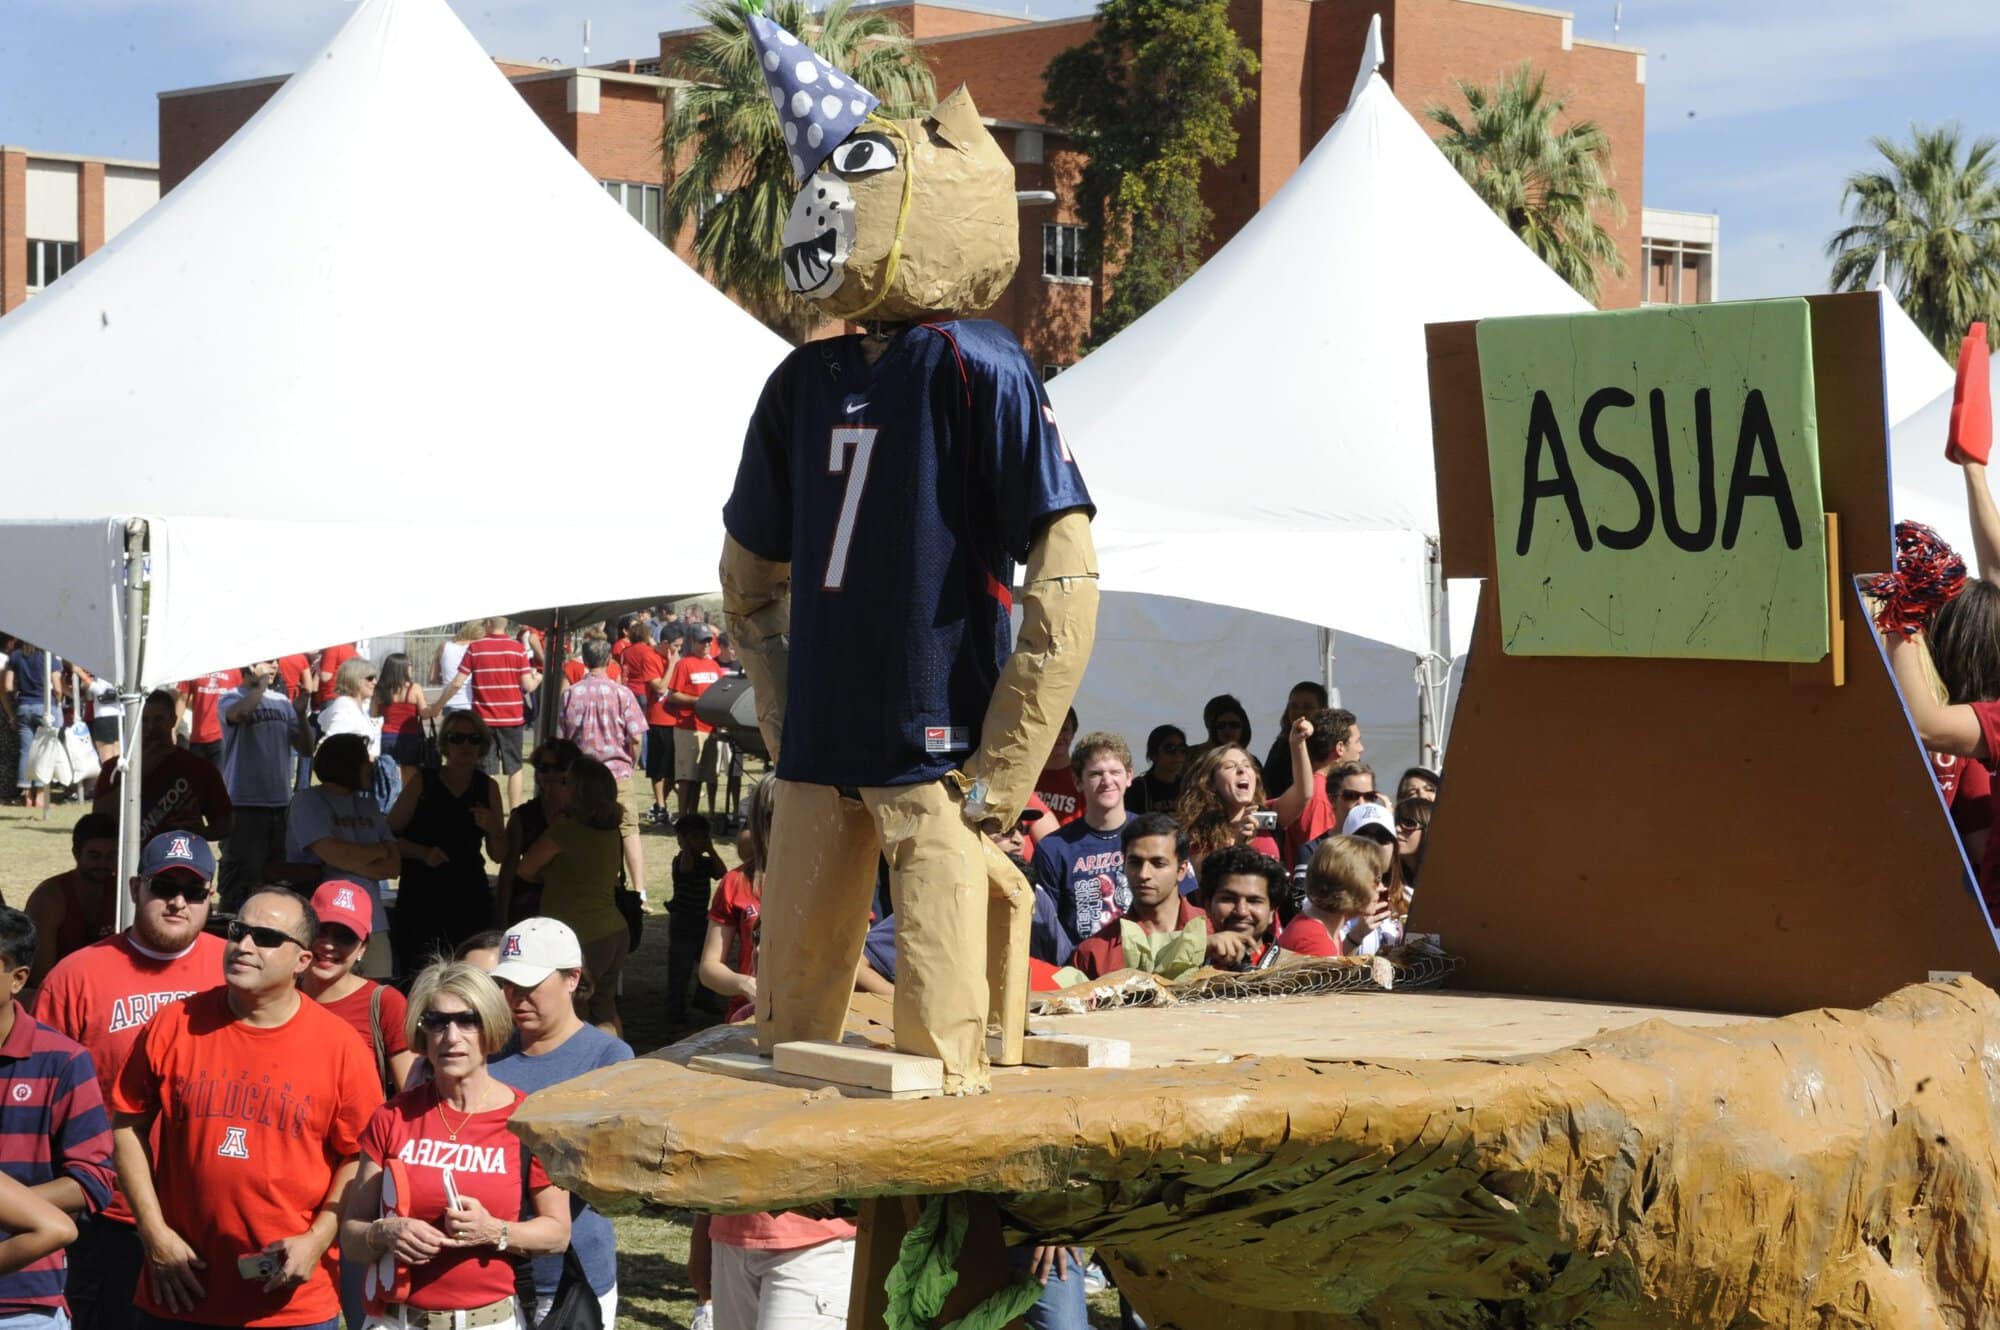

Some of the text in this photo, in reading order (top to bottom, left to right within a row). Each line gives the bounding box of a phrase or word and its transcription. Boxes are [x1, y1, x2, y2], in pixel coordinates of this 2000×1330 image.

[1516, 387, 1803, 556] ASUA
[823, 425, 881, 591] 7
[158, 777, 189, 812] ZOO
[1037, 791, 1076, 813] CATS
[165, 837, 193, 860] A
[332, 887, 355, 911] A
[1074, 879, 1092, 938] TENNIS
[1089, 877, 1103, 921] CLUB
[502, 934, 521, 957] A
[176, 1068, 313, 1104] ARIZONA
[175, 1079, 307, 1139] WILDCATS
[217, 1126, 249, 1159] A
[398, 1138, 508, 1175] ARIZONA
